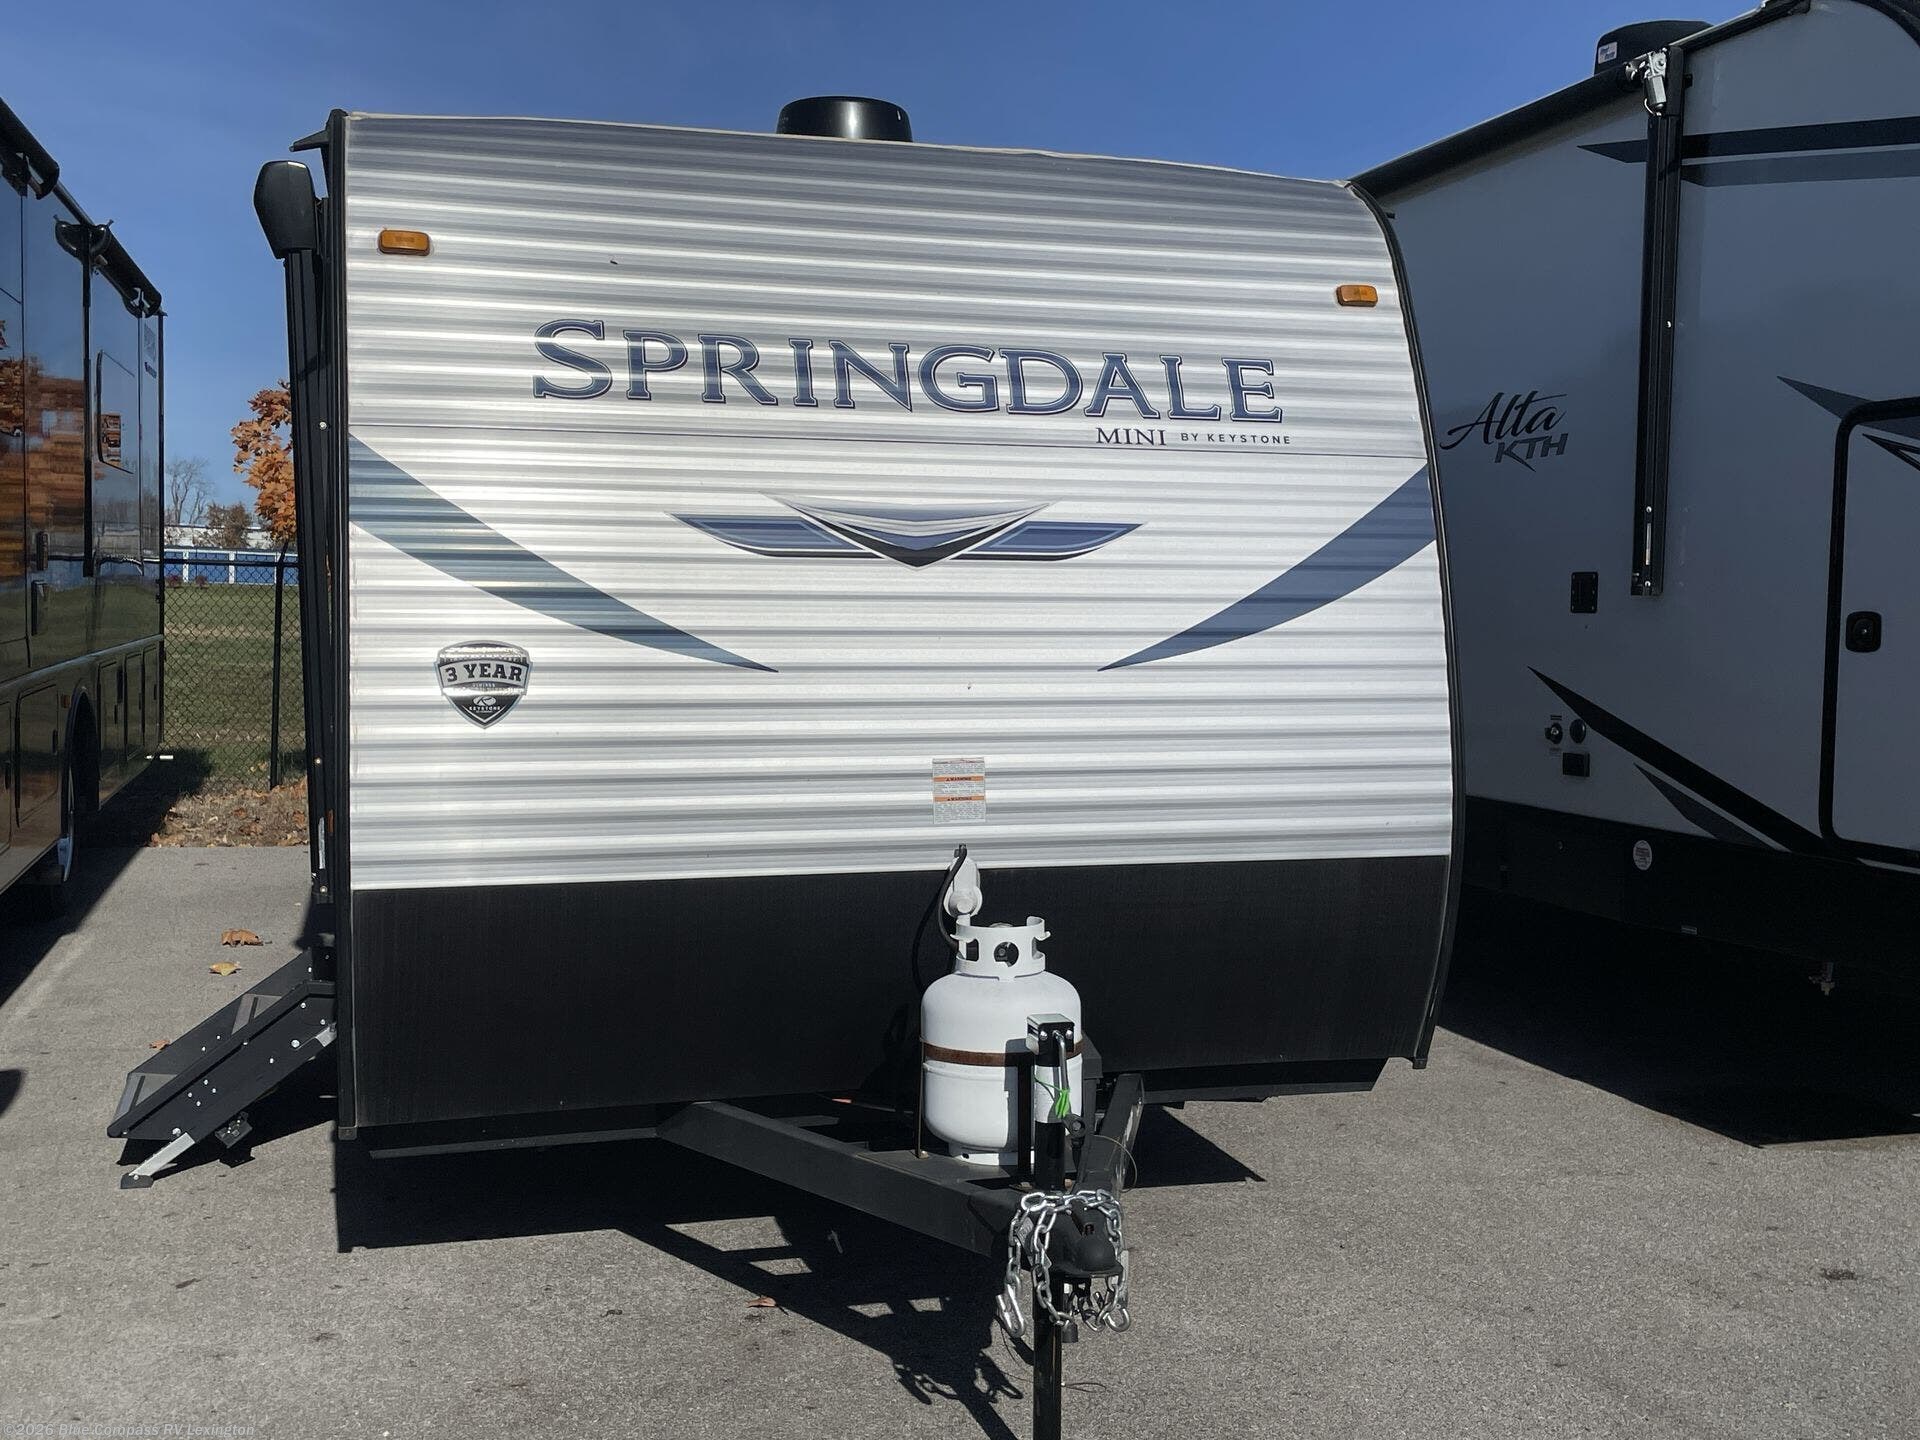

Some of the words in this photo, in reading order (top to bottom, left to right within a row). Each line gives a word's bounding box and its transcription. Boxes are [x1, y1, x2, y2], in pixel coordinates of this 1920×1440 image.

[534, 319, 1283, 424] SPRINGDALE
[1096, 427, 1168, 446] MINI
[1181, 432, 1199, 442] BY
[1207, 433, 1291, 444] KEYSTONE
[1440, 390, 1568, 450] Alta
[1494, 432, 1569, 473] KTH
[445, 667, 458, 682] 3
[463, 663, 522, 682] YEAR
